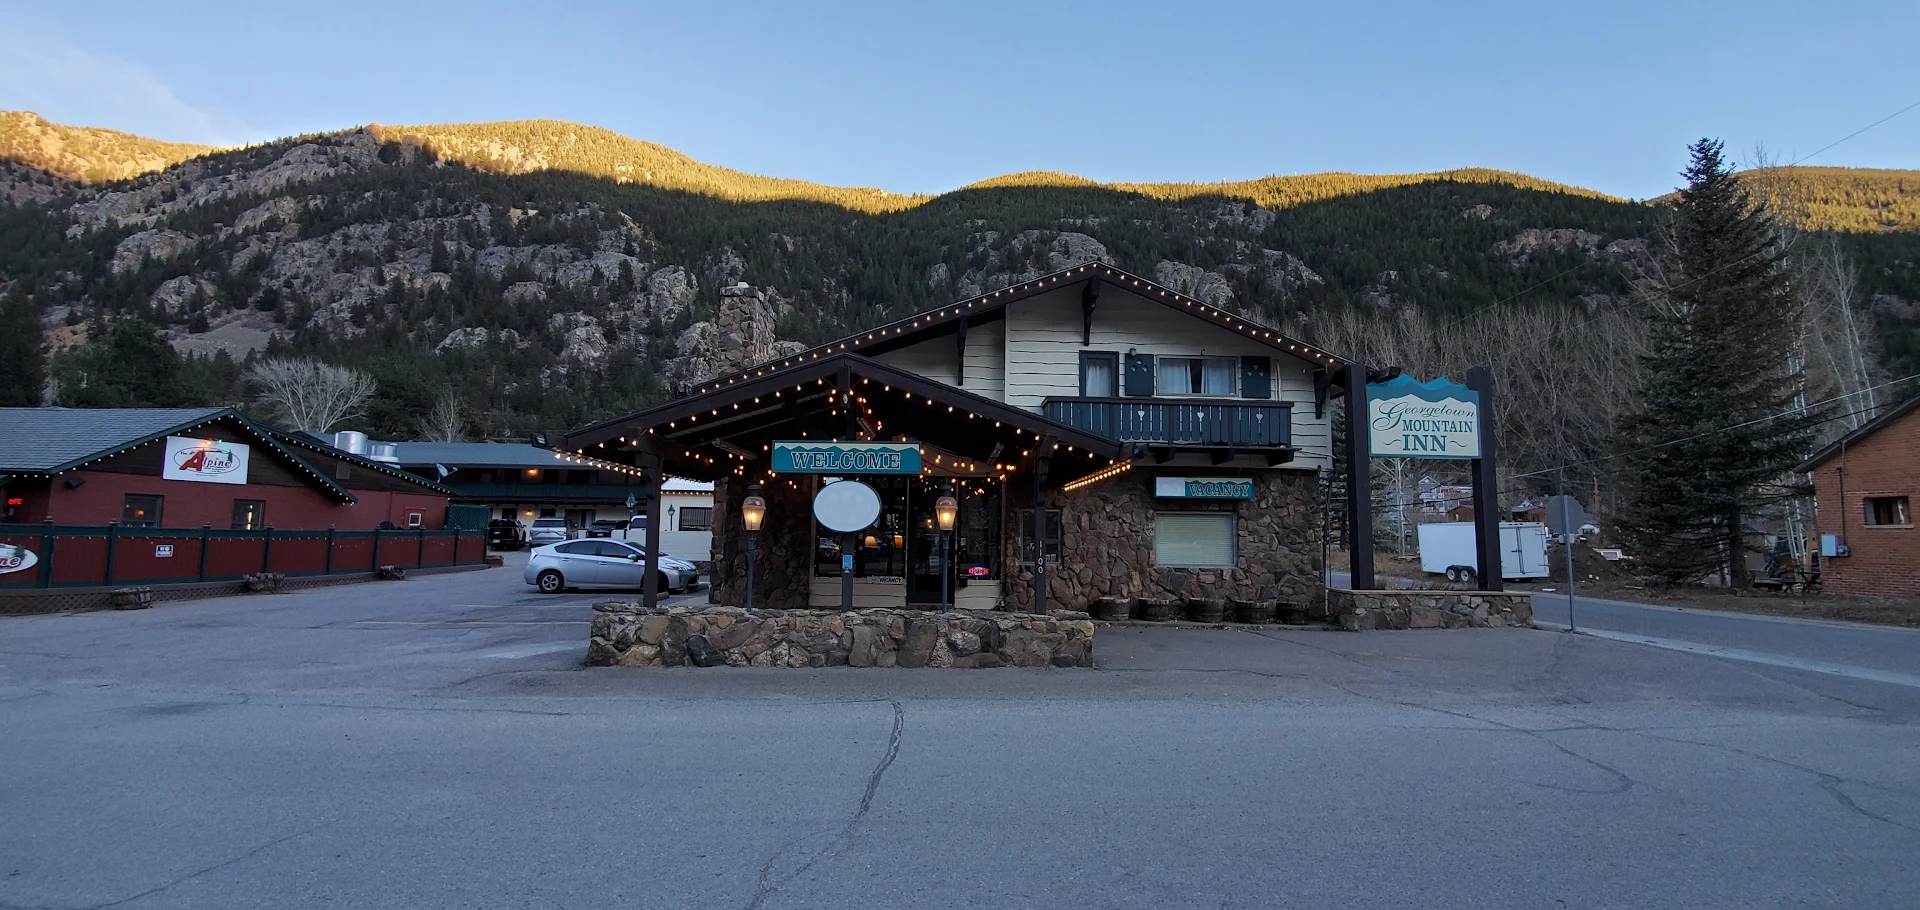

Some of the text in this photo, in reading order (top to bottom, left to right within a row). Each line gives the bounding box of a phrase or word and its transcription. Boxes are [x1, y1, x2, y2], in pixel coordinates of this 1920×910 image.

[1372, 402, 1476, 431] Georgetown
[1402, 419, 1473, 433] MOUNTAIN
[1402, 434, 1447, 452] INN
[179, 449, 231, 472] Alpine
[791, 452, 901, 469] WELCOME
[1189, 484, 1250, 497] VACANCY
[968, 568, 989, 577] OPEN
